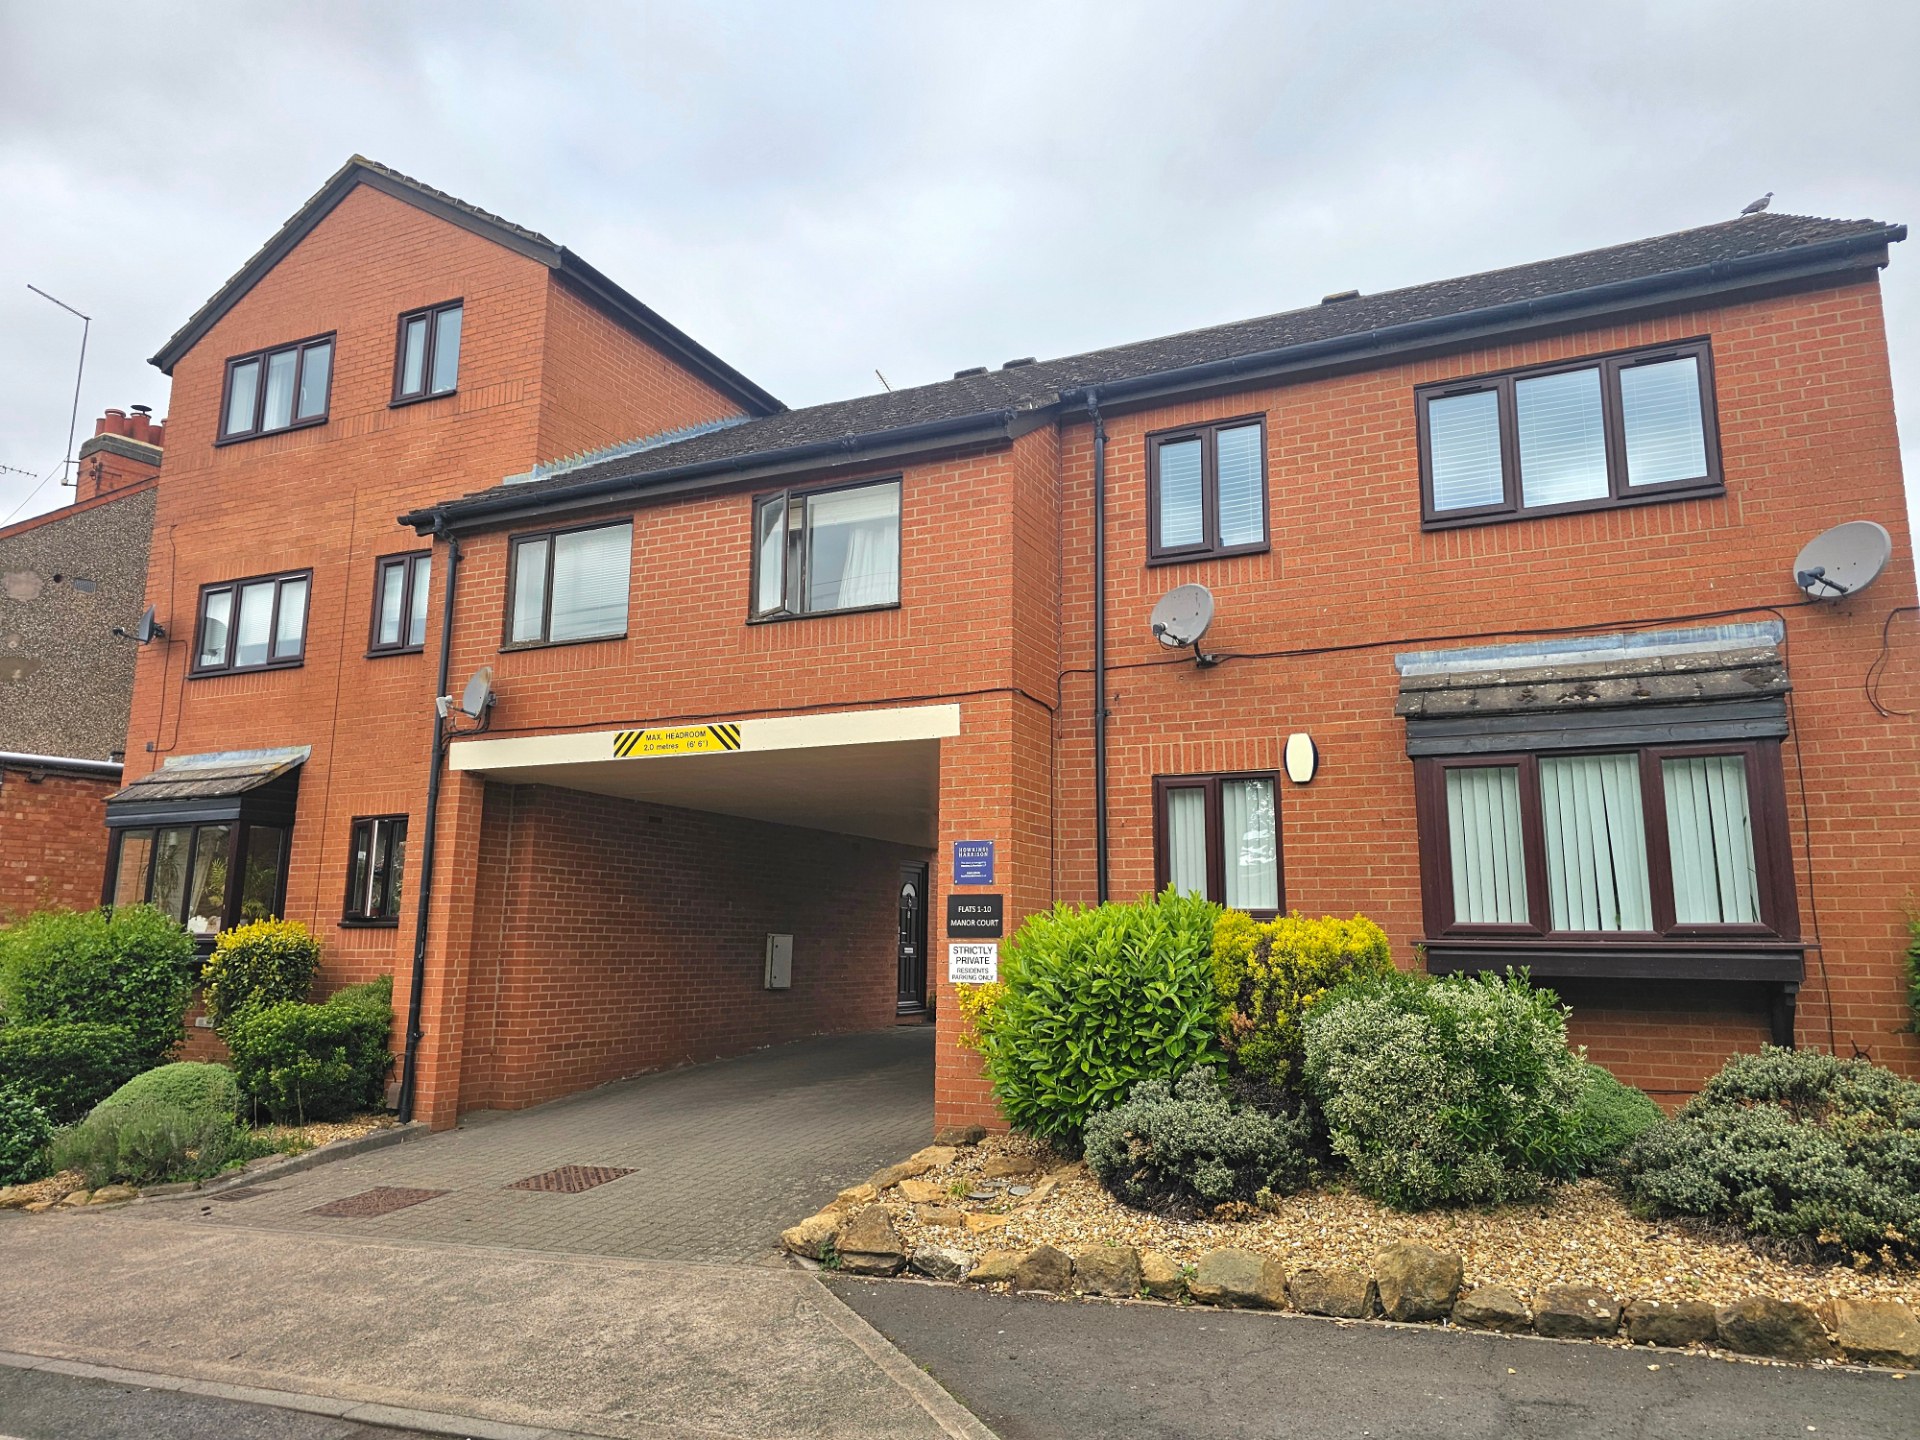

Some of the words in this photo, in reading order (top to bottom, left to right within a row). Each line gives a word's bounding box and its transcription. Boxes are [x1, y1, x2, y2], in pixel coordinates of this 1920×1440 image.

[665, 731, 706, 739] HEADROOM
[643, 743, 655, 751] 2.0
[958, 905, 976, 913] FLATS
[977, 905, 992, 913] 1-10
[950, 919, 976, 927] MANOR
[976, 919, 999, 927] COURT
[953, 946, 993, 955] STRICTLY
[955, 956, 990, 965] PRIVATE
